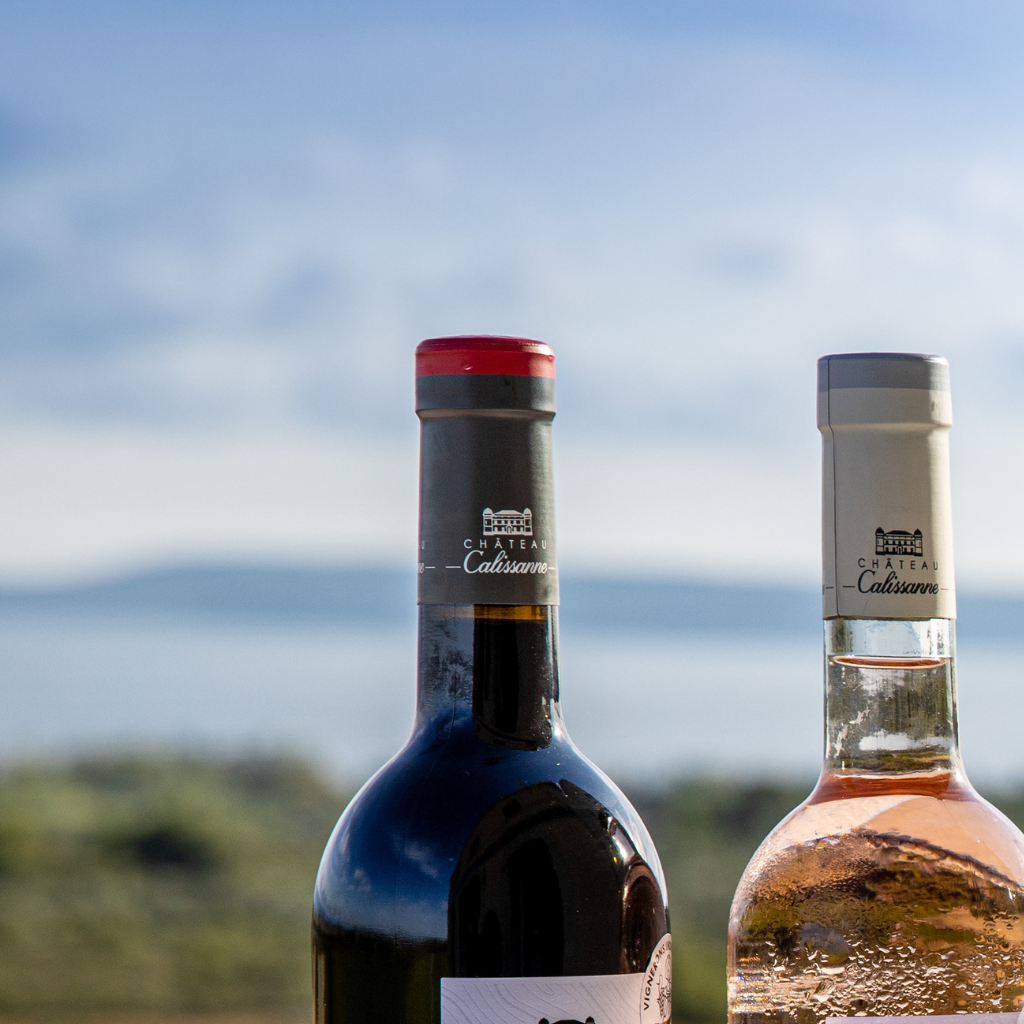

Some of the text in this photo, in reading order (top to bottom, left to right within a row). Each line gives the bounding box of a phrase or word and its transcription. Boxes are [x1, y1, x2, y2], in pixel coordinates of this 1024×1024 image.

[463, 538, 547, 549] CHÂTEAU
[463, 550, 548, 574] Calissanne
[858, 558, 939, 570] CHÂTEAU
[857, 569, 939, 594] Calissanne
